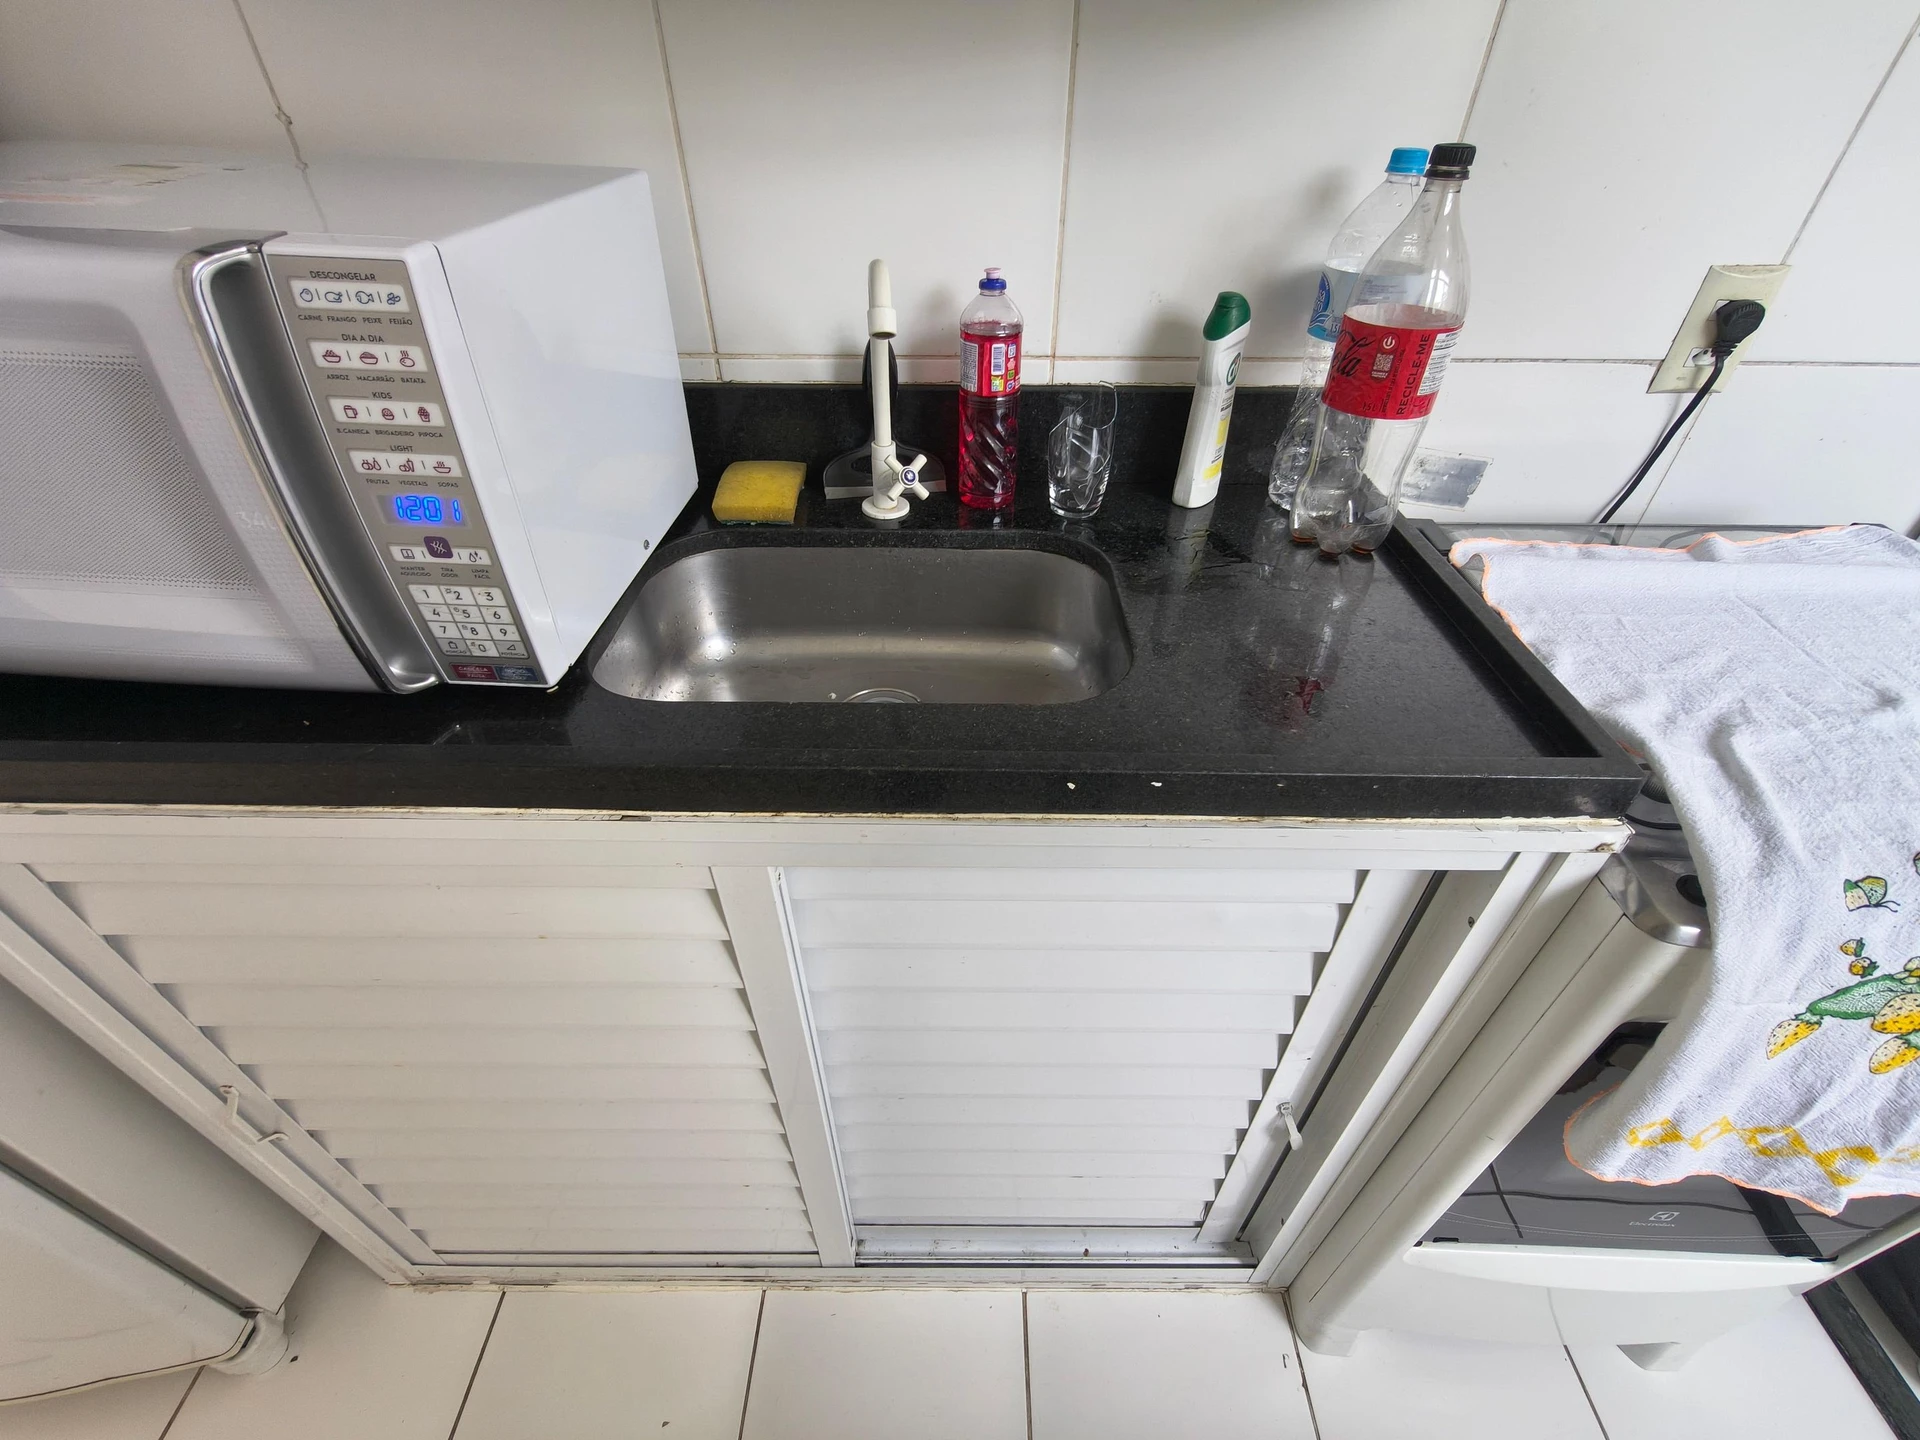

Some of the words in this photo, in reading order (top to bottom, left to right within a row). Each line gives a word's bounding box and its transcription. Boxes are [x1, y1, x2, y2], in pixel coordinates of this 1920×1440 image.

[309, 270, 377, 281] DESCONGELAR
[298, 314, 323, 322] CARNE
[327, 315, 357, 323] FRANGO
[389, 316, 413, 326] FEIJÃO
[341, 333, 358, 342] DIA
[359, 334, 366, 342] A
[368, 335, 385, 343] DIA
[356, 373, 395, 383] MACARRÃO
[400, 376, 426, 384] BATATA
[1396, 333, 1431, 416] RECICLE-ME
[371, 391, 393, 400] KIDS
[374, 429, 415, 437] BRIGADEIRO
[389, 445, 414, 453] LIGHT
[365, 478, 390, 486] FRUTAS
[423, 589, 430, 599] 1
[453, 590, 463, 600] 2
[484, 591, 494, 601] 3
[432, 608, 441, 617] 4
[462, 609, 471, 618] 5
[493, 610, 501, 620] 6
[439, 625, 446, 634] 7
[470, 627, 479, 636] 8
[499, 628, 507, 637] 9
[478, 643, 487, 652] 0
